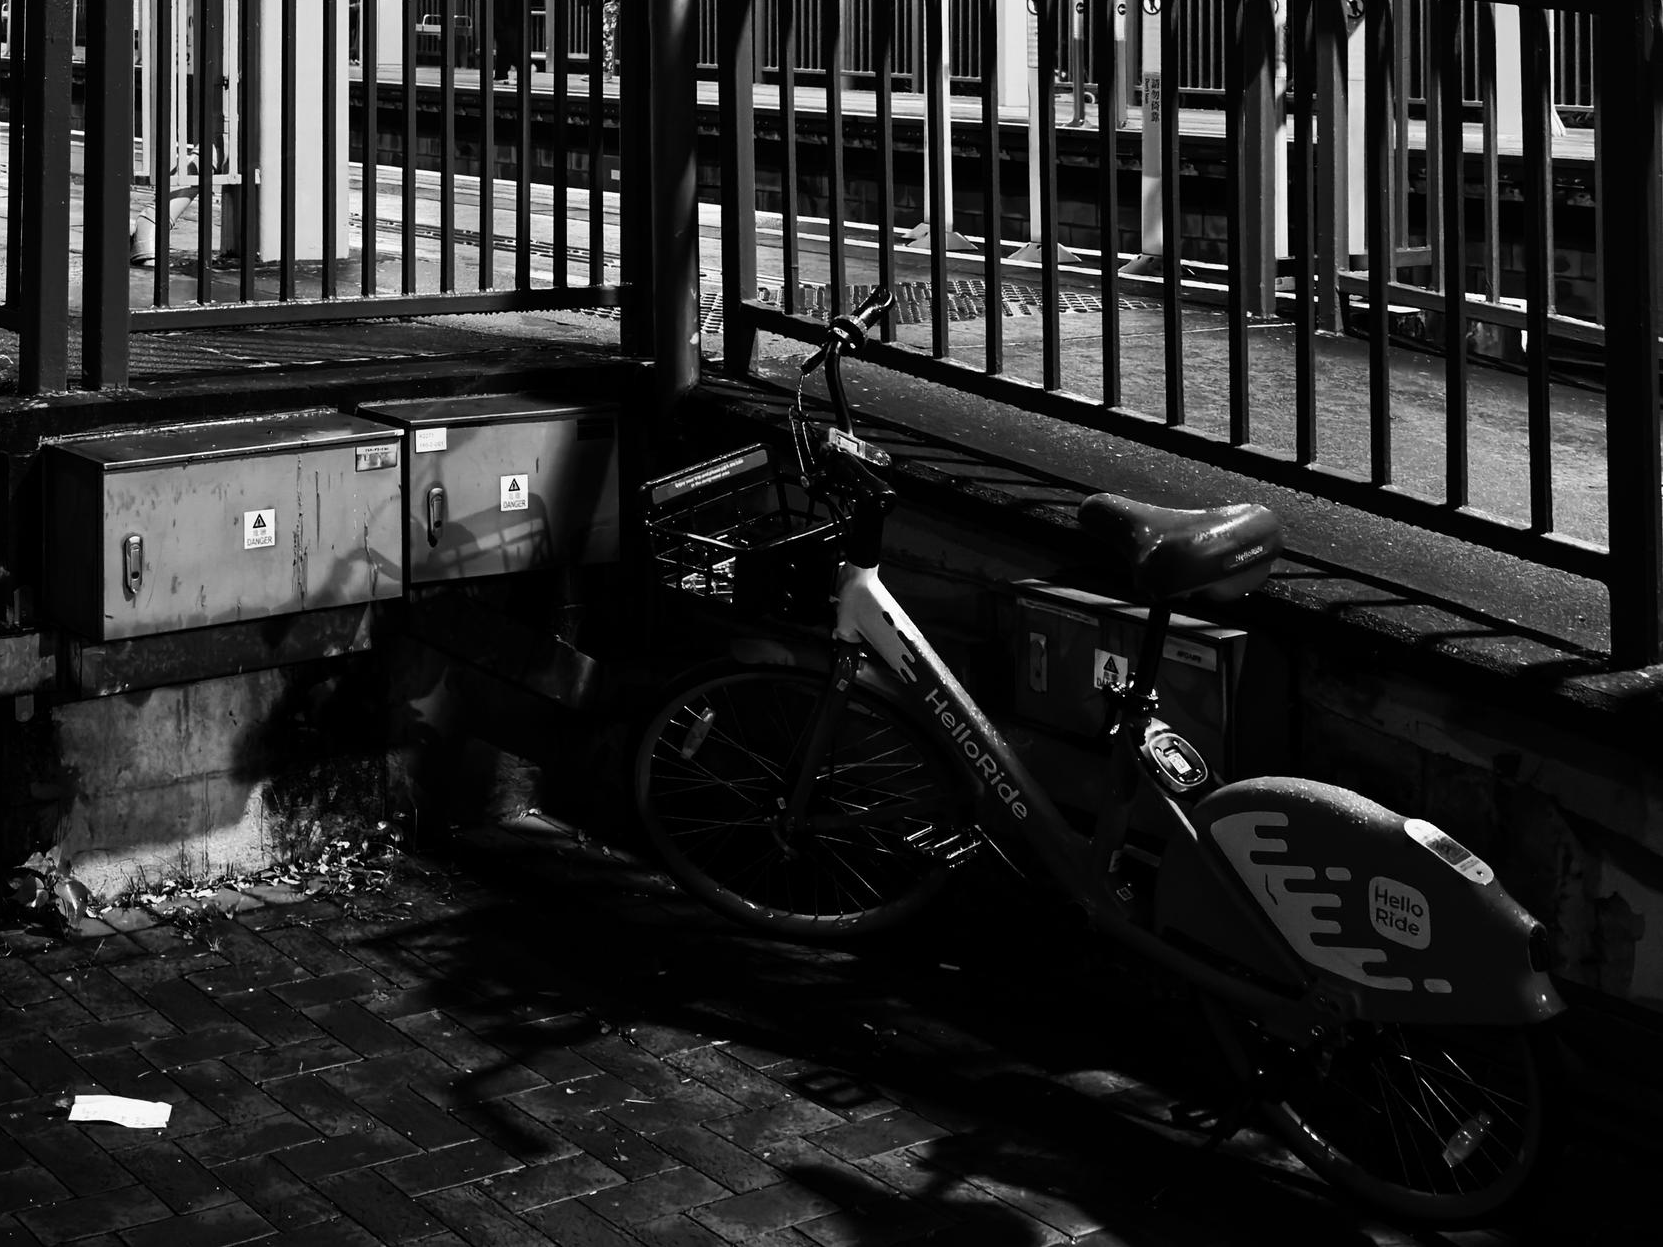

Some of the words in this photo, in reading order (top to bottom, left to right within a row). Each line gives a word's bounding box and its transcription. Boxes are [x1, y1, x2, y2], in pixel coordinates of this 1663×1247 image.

[502, 499, 526, 509] DANGER
[246, 536, 273, 546] DANGER
[924, 688, 1028, 820] HelloRide
[1374, 884, 1424, 918] Hello
[1374, 907, 1421, 937] Ride
